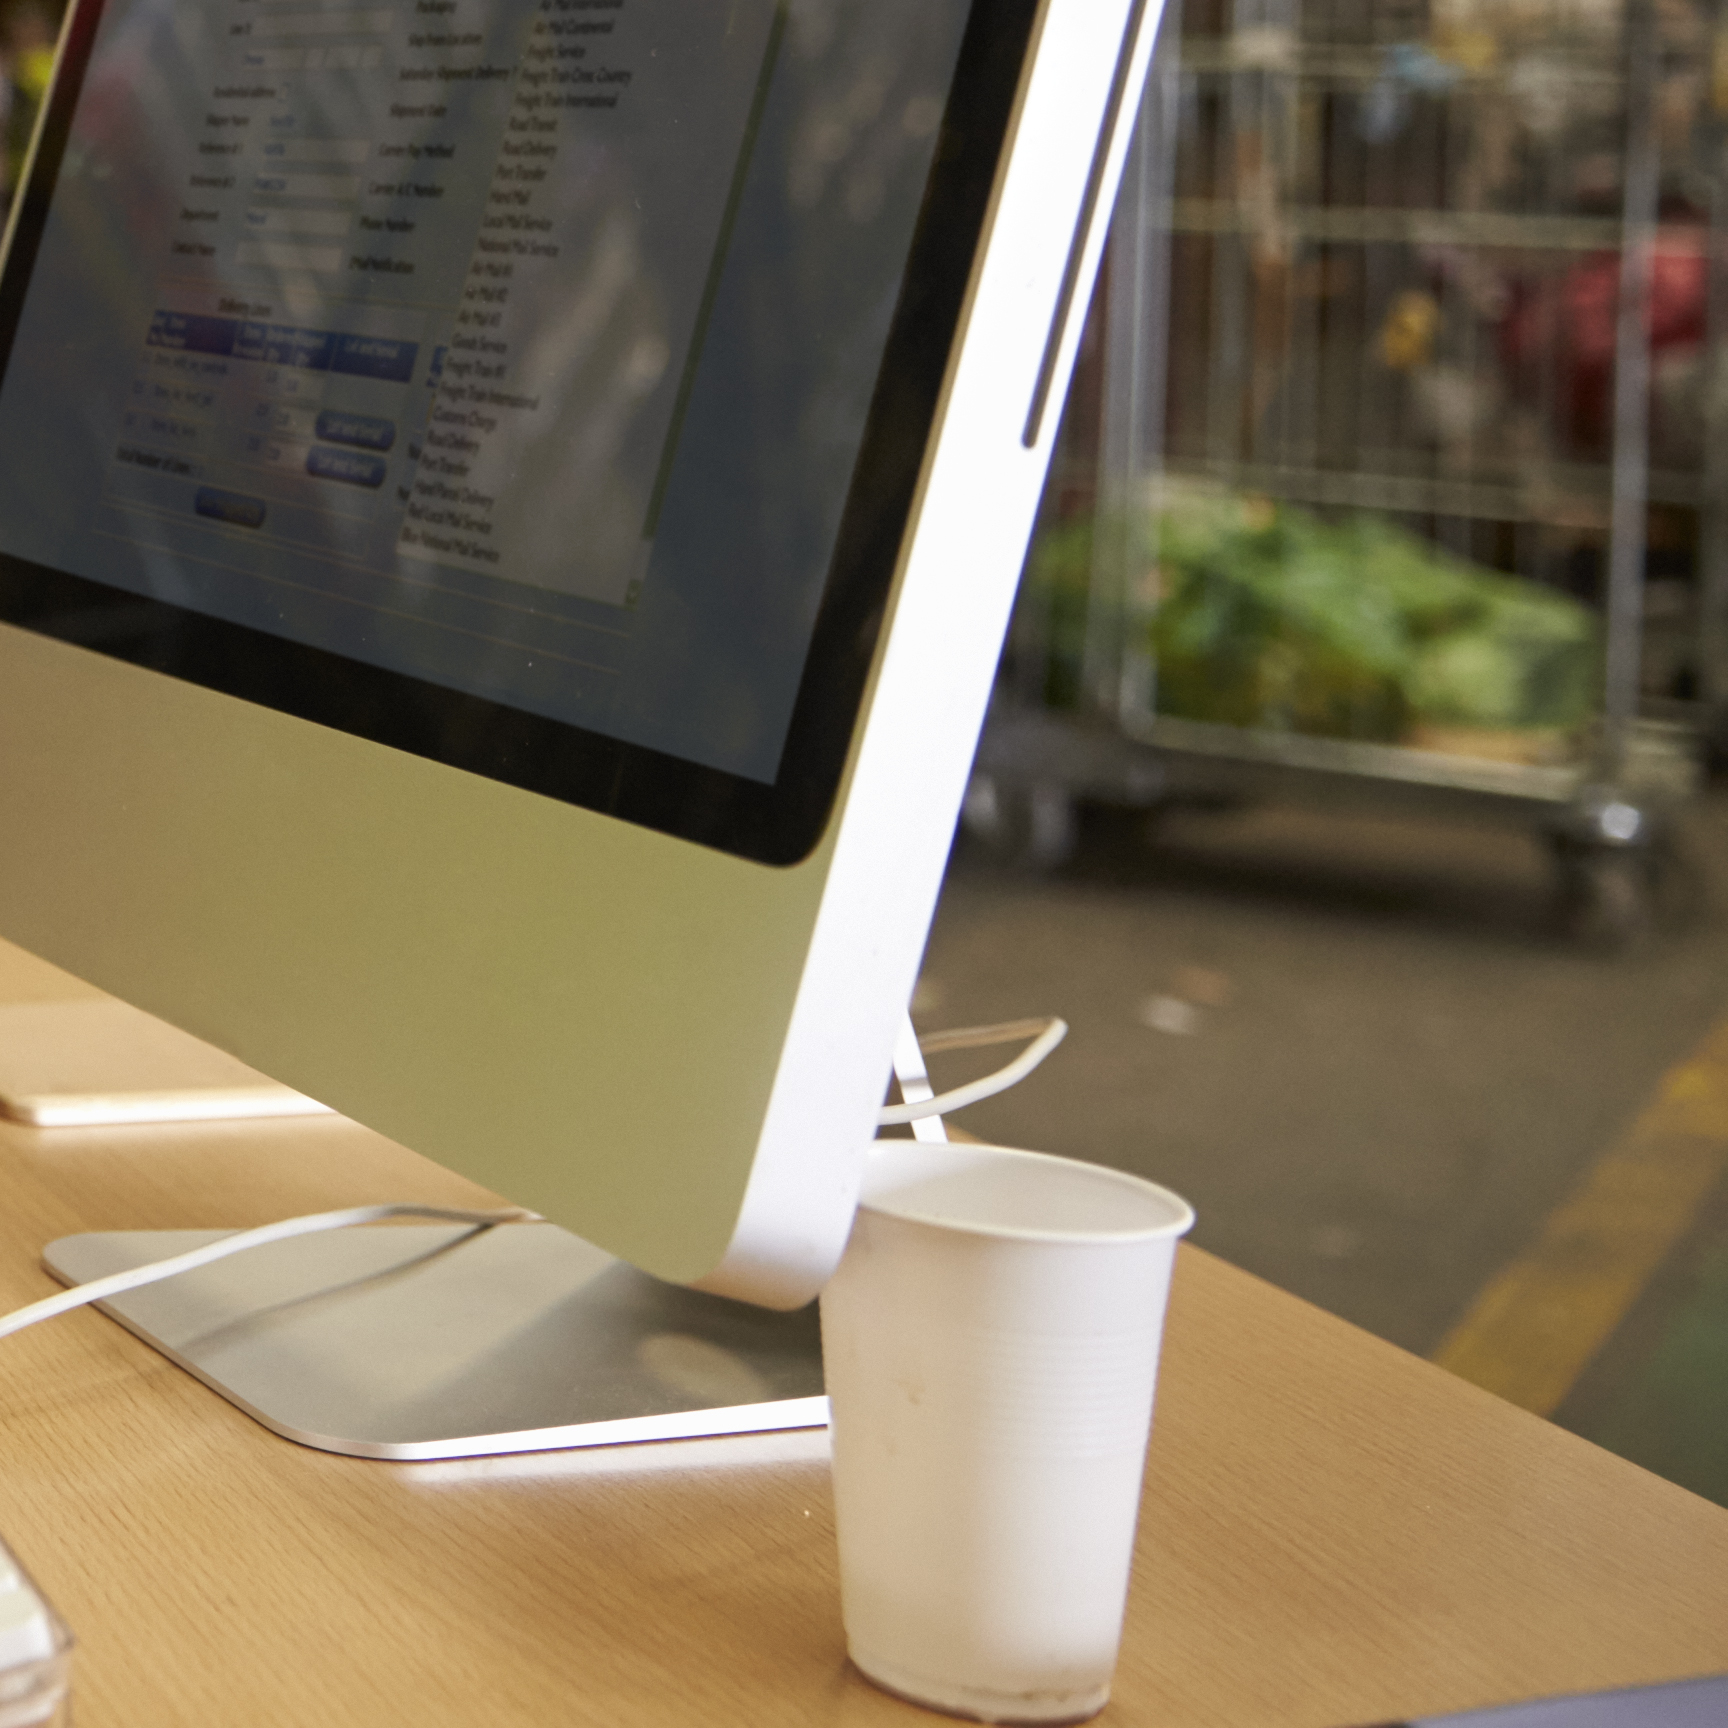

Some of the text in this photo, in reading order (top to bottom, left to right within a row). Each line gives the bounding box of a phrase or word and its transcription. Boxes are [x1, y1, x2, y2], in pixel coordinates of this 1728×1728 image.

[534, 21, 614, 35] Air Mail Continental
[526, 45, 586, 62] Freight Service
[437, 66, 474, 80] Shipment
[474, 66, 509, 80] Delivery
[520, 69, 549, 85] Freight
[552, 69, 571, 82] Train
[595, 68, 632, 85] Country
[515, 93, 618, 110] Freight Train International
[390, 104, 426, 118] Shipment
[509, 117, 530, 130] Road
[423, 144, 454, 158] Method
[502, 141, 558, 160] Road Delivery
[496, 165, 547, 181] Port Transfer
[413, 184, 443, 197] Number
[490, 191, 529, 204] Hand Mail
[384, 218, 415, 233] Number
[482, 215, 553, 232] Local Mail Service
[478, 237, 560, 257] National Mail Service
[471, 262, 483, 275] Air
[485, 263, 502, 277] Mail
[464, 288, 477, 299] Air
[479, 286, 496, 301] Mail
[458, 310, 471, 323] Air
[472, 311, 490, 326] Mail
[479, 337, 508, 355] Service
[446, 357, 474, 378] Freight
[475, 361, 494, 377] Train
[439, 381, 538, 410] Freight Train International
[432, 405, 498, 434] Customs Charge
[426, 429, 480, 452] Road Delivery
[421, 454, 469, 477] Port Transfer
[415, 481, 435, 496] Hand
[461, 489, 495, 512] Delivery
[408, 503, 493, 535] Red Local Mail Service
[421, 532, 452, 552] National
[453, 539, 471, 556] Mail
[470, 543, 500, 563] Service
